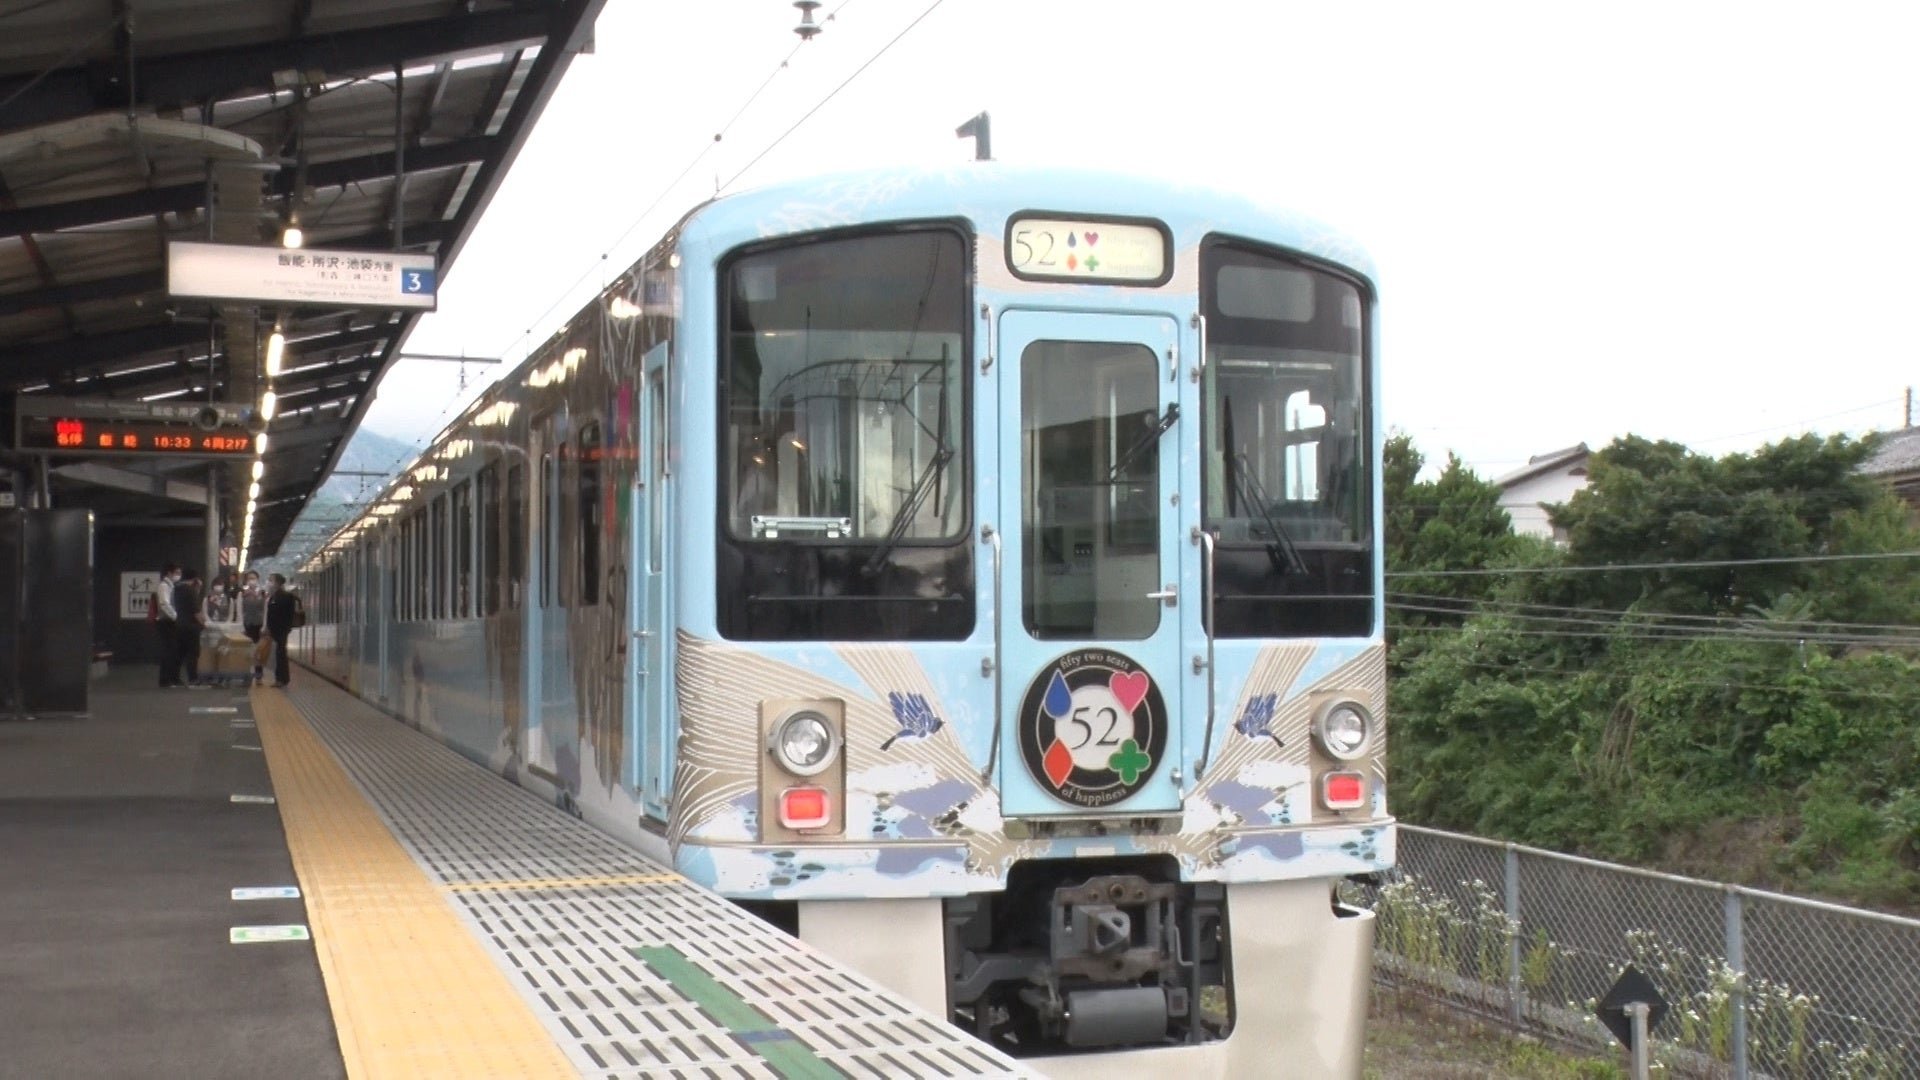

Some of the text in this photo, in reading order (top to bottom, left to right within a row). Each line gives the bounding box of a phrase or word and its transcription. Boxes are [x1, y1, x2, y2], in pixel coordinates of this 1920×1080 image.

[955, 110, 991, 160] 1
[1013, 230, 1056, 268] 52
[407, 272, 422, 292] 3
[1060, 653, 1131, 670] fifty two seats
[1071, 706, 1120, 750] 52
[1062, 787, 1128, 806] of happiness
